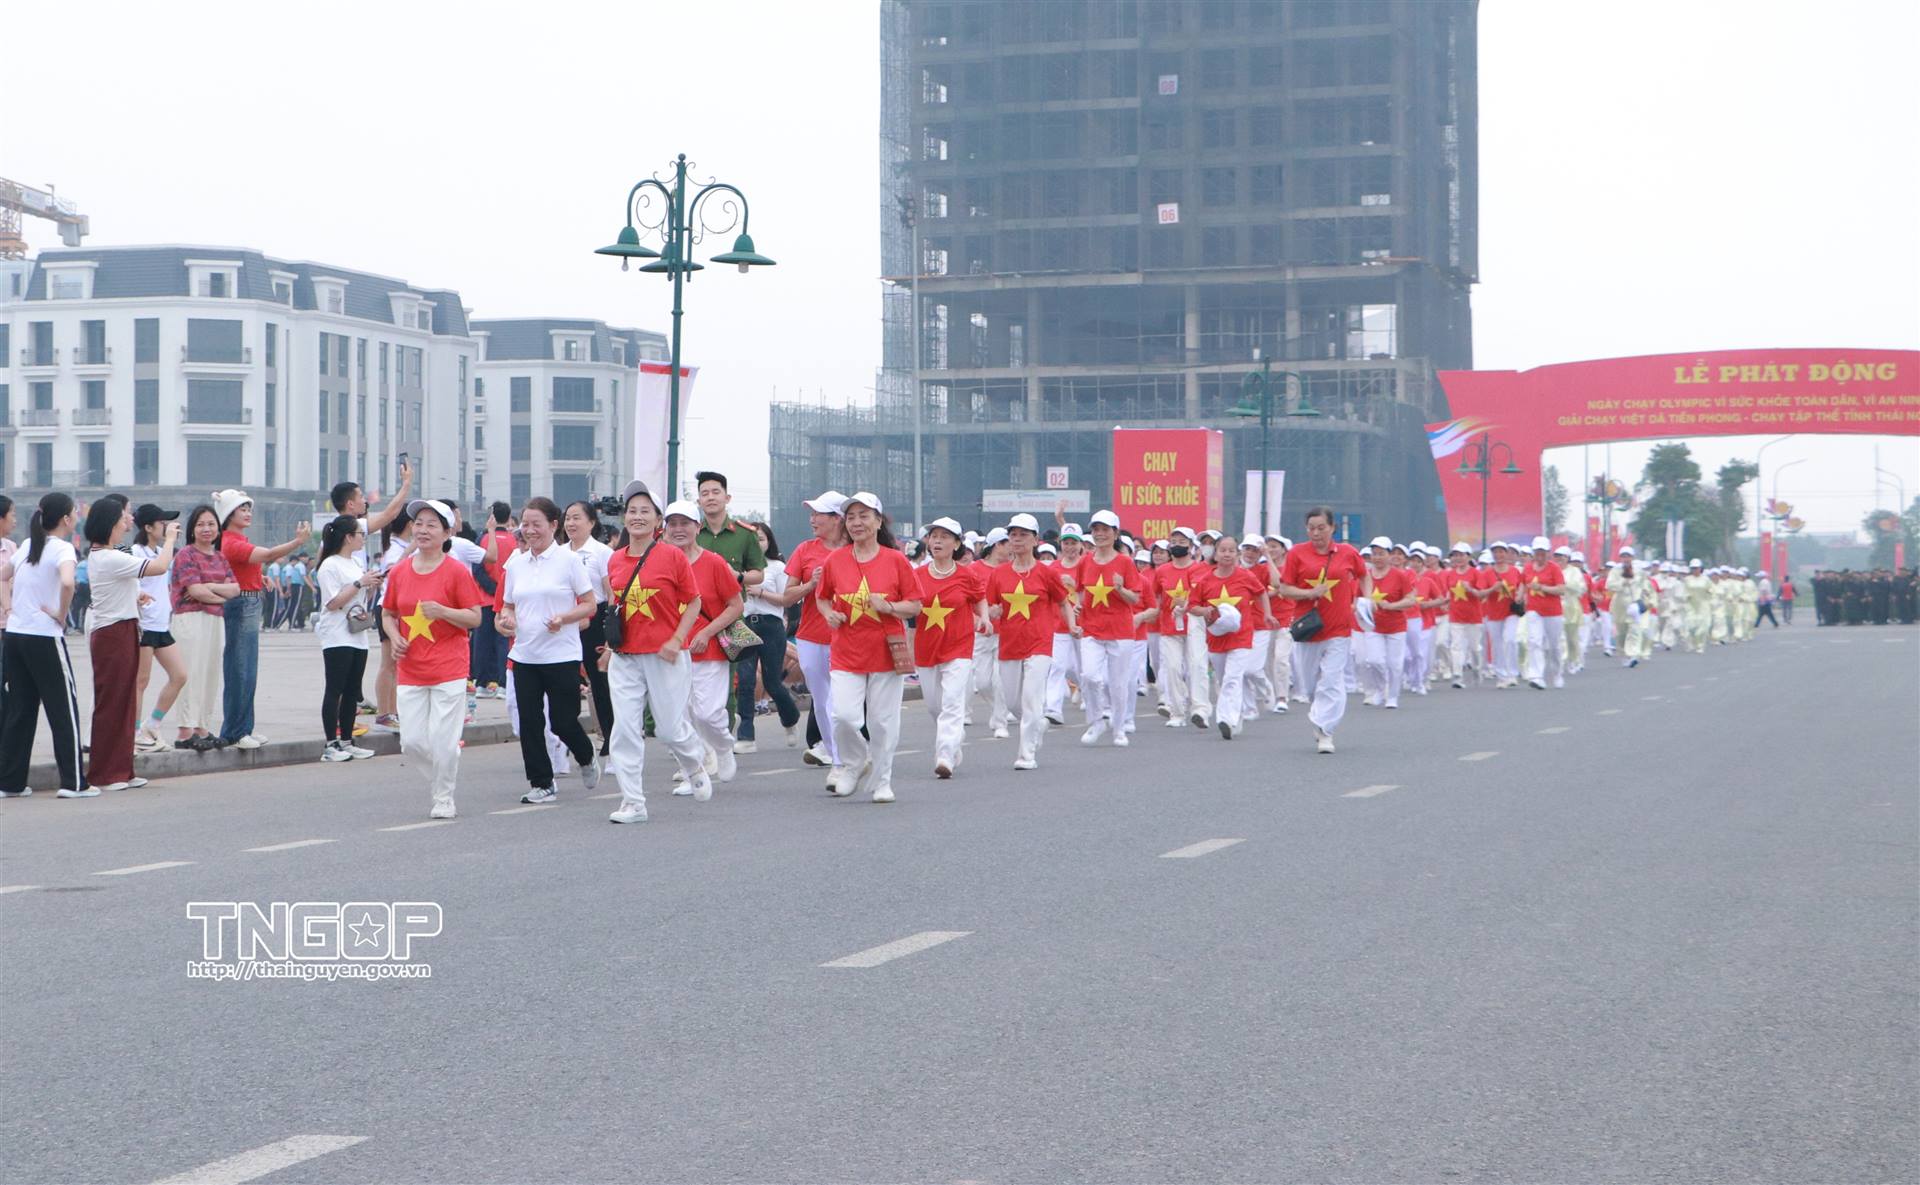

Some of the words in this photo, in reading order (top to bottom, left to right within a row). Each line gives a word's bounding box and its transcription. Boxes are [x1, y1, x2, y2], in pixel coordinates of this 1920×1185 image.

[1161, 209, 1175, 221] 06
[1674, 358, 1709, 384] LỄ
[1719, 360, 1800, 383] PHÁT
[1809, 359, 1897, 386] ĐỘNG
[1587, 397, 1620, 410] NGÀY
[1659, 397, 1711, 409] OLYMPIC
[1878, 395, 1896, 406] AN
[1619, 413, 1645, 426] VIỆT
[1698, 412, 1742, 424] PHONG
[1142, 451, 1177, 476] CHẠY
[1050, 472, 1065, 486] 02
[1120, 481, 1134, 506] VÌ
[1136, 480, 1161, 506] SỨC
[1165, 479, 1199, 506] KHỎE
